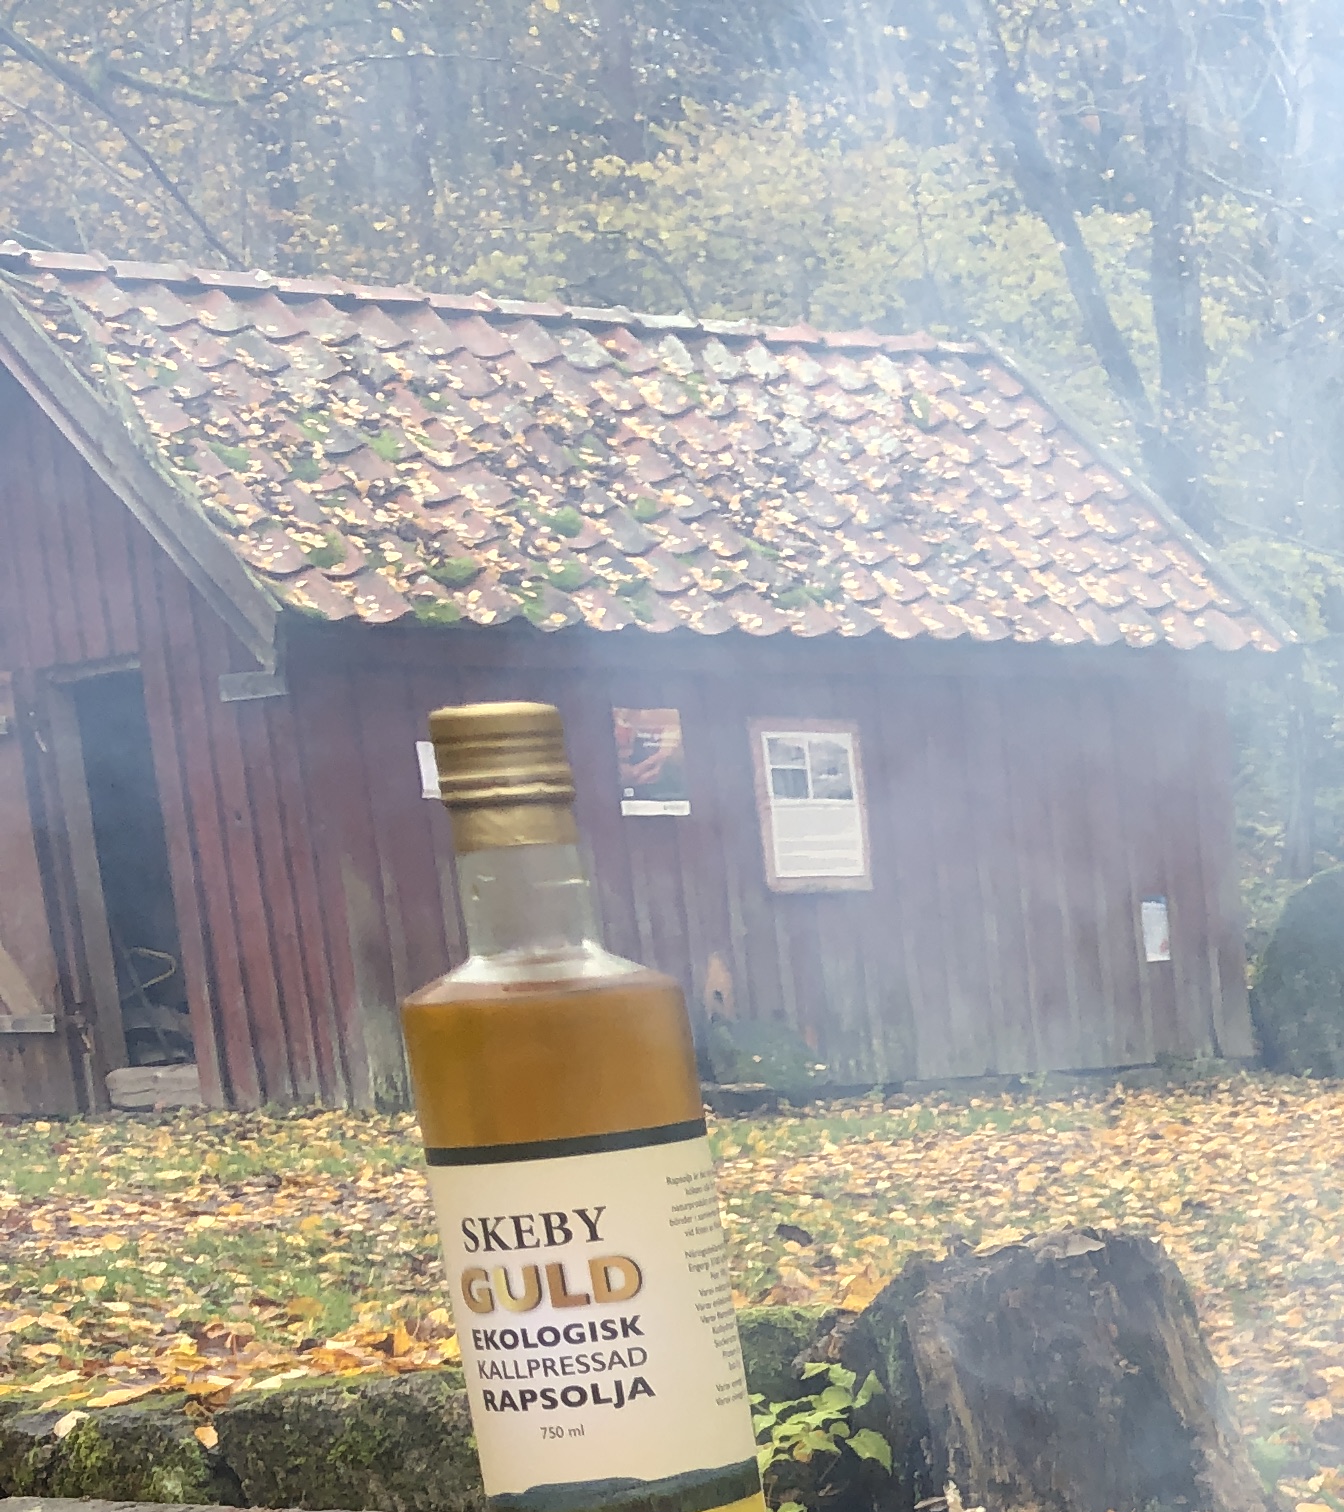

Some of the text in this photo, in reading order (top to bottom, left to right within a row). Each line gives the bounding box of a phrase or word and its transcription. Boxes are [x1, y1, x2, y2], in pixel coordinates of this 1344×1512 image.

[461, 1206, 606, 1253] SKEBY
[461, 1255, 643, 1314] GULD
[472, 1315, 645, 1351] EKOLOGISK
[477, 1346, 648, 1380] KALLPRESSAD
[482, 1376, 656, 1412] RAPSOLJA
[540, 1424, 585, 1440] 750 ml
